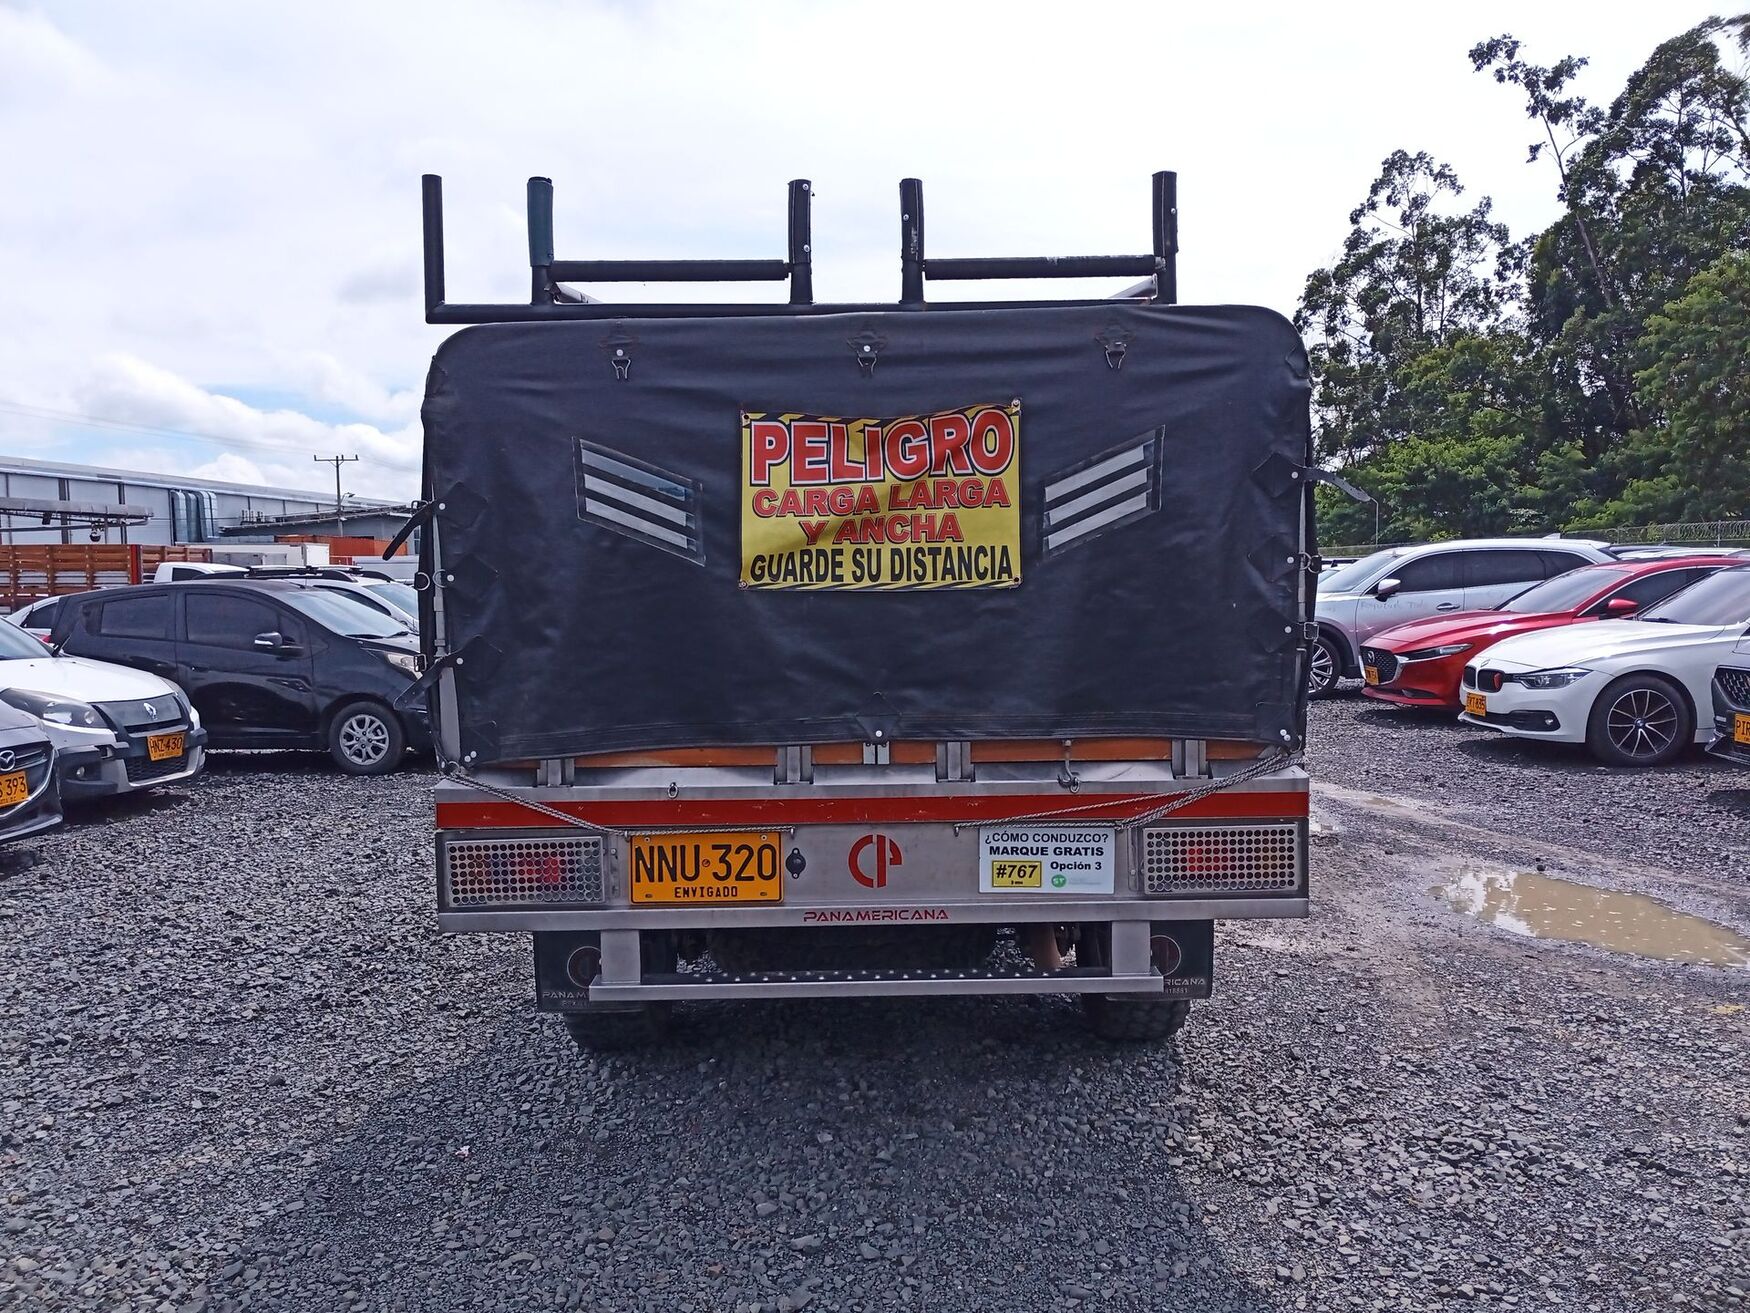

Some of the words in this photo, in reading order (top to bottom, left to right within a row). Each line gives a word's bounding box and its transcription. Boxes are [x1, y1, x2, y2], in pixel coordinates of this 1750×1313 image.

[750, 409, 1014, 486] PELIGRO
[752, 485, 880, 517] CARGA
[888, 478, 1011, 511] LARGA
[799, 520, 829, 545] Y
[832, 513, 964, 545] ANCHA
[750, 548, 844, 582] GUARDE
[851, 547, 882, 582] SU
[890, 545, 1013, 581] DISTANCIA
[5, 775, 26, 796] 393
[985, 831, 1029, 844] ¿CÓMO
[1032, 833, 1109, 844] CONDUZCO?
[989, 845, 1049, 857] MARQUE
[1053, 847, 1104, 857] GRATIS
[996, 864, 1038, 879] #767
[1050, 861, 1091, 872] Opción
[1095, 862, 1102, 871] 3
[674, 886, 738, 898] ENVIGADO
[803, 909, 949, 922] PANAMERICANA
